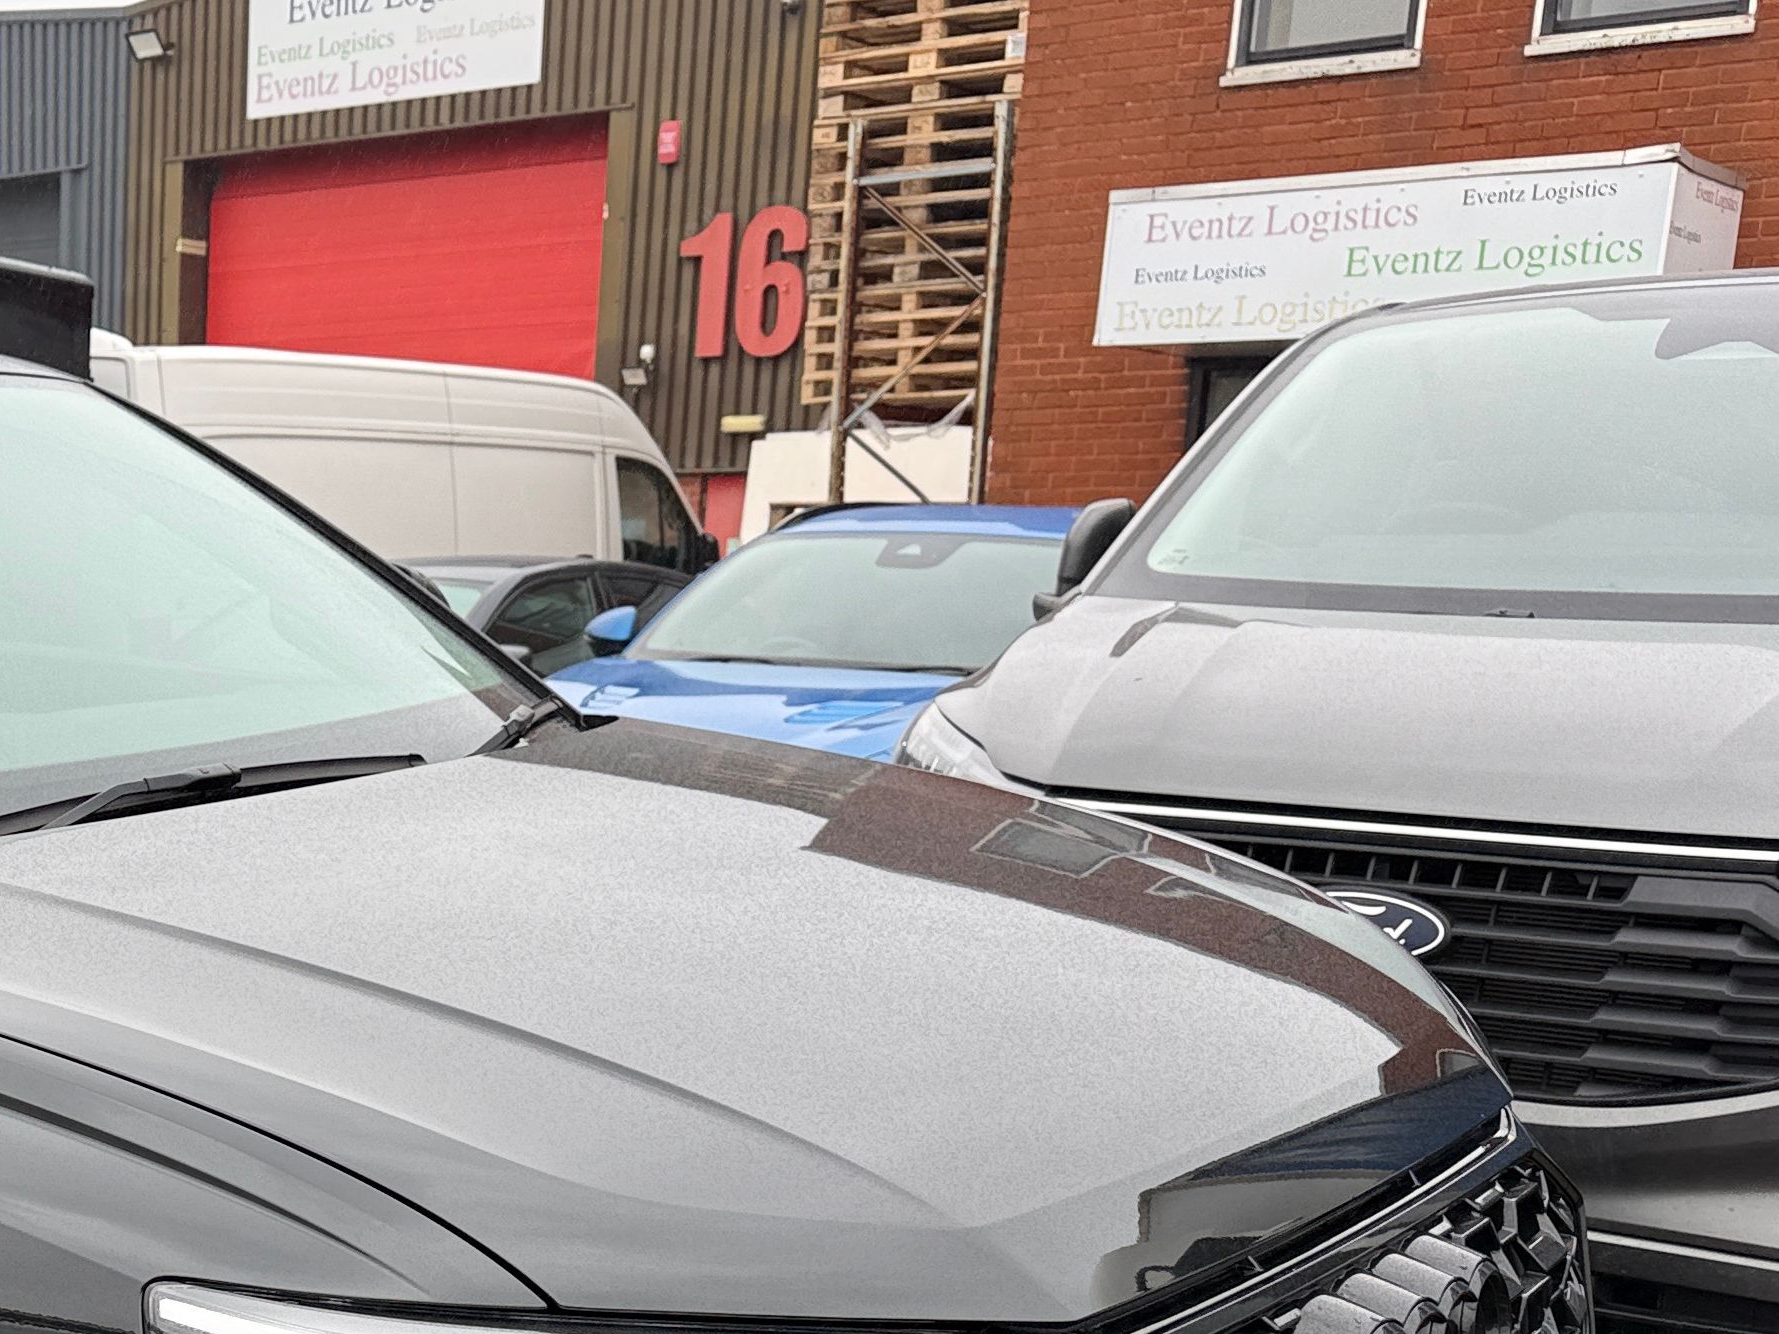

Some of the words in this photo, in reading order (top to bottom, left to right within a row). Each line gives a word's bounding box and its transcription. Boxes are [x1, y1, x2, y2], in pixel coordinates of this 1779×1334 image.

[415, 23, 464, 43] Eventz
[470, 11, 536, 37] Logistics
[257, 41, 312, 66] Eventz
[318, 28, 395, 60] Logistics
[255, 69, 339, 104] Eventz
[349, 48, 467, 95] Logistics
[1462, 187, 1525, 206] Eventz
[1531, 179, 1618, 204] Logistics
[1144, 211, 1254, 243] Eventz
[1264, 198, 1418, 242] Logistics
[1134, 266, 1188, 285] Eventz
[1192, 260, 1266, 283] Logistics
[1344, 245, 1464, 278] Eventz
[1474, 231, 1644, 277] Logistics
[679, 205, 809, 358] 16
[1114, 300, 1224, 332] Eventz
